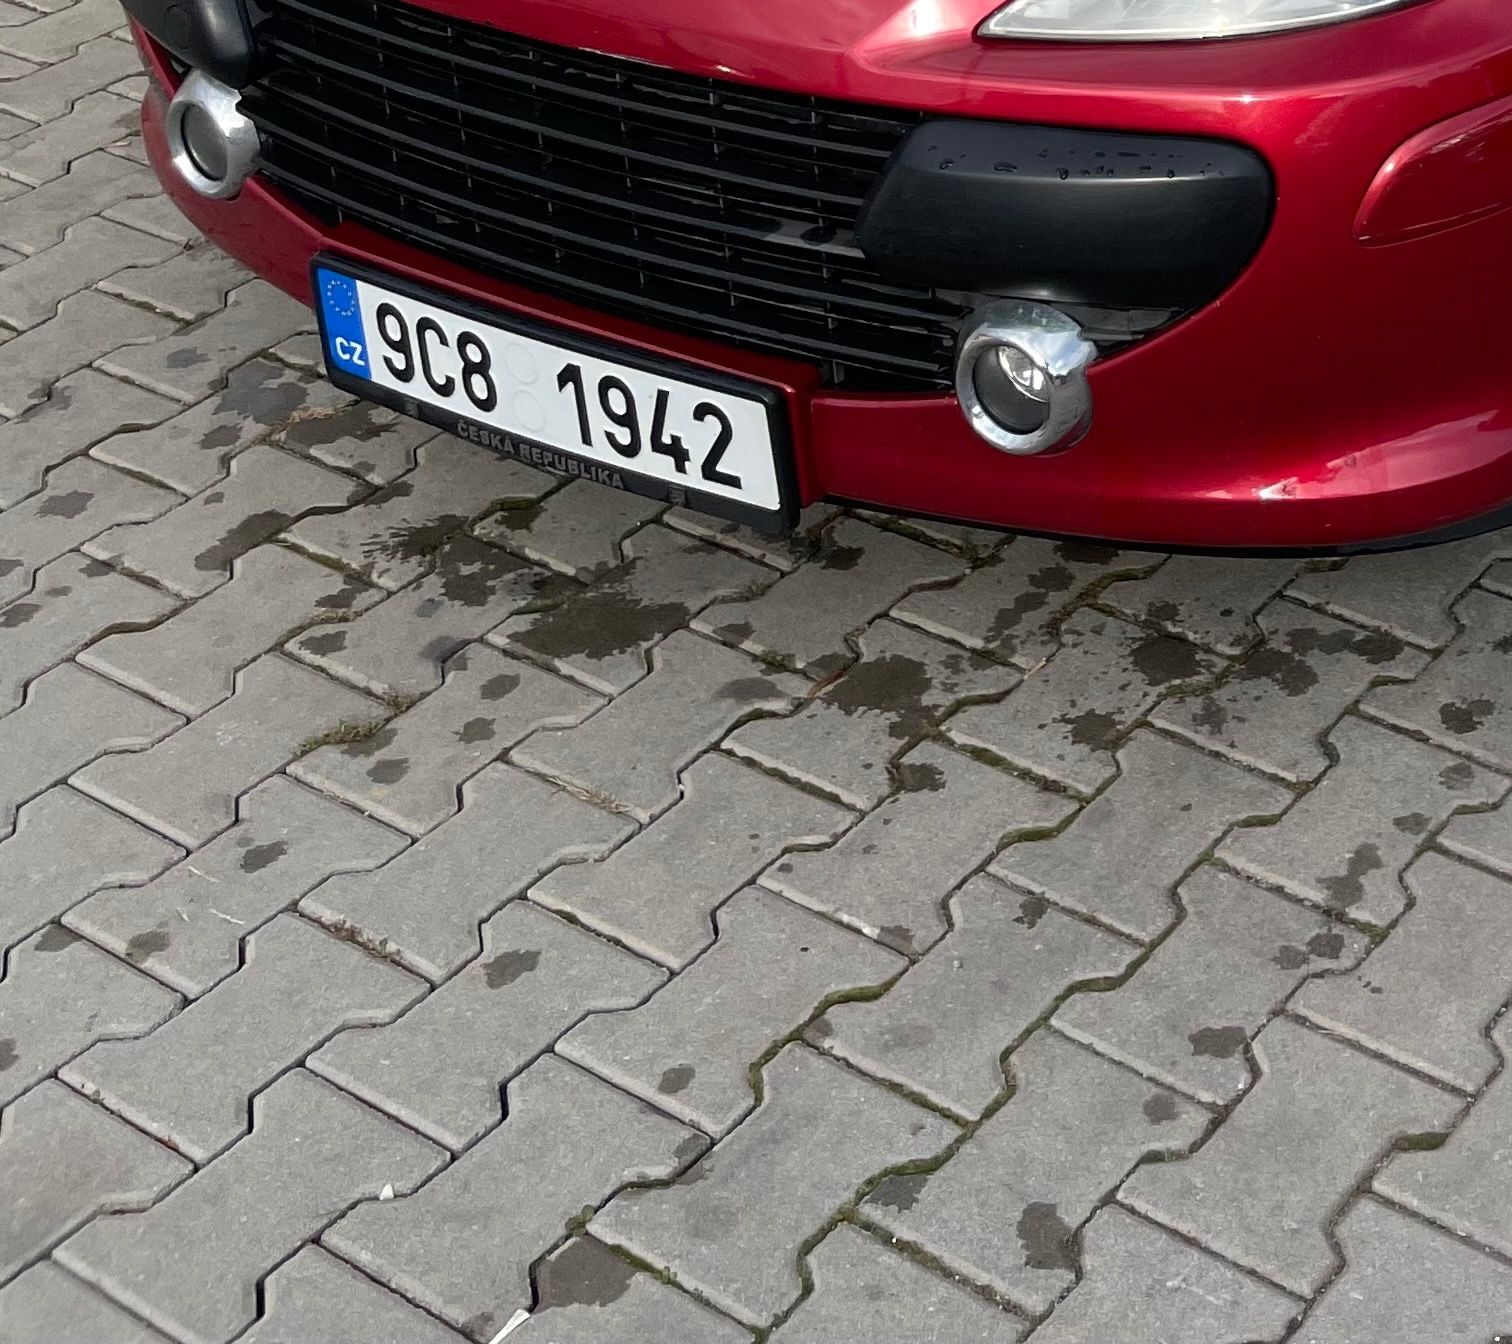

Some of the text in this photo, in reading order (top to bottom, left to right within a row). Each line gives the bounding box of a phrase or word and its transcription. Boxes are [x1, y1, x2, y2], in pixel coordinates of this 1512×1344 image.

[335, 302, 744, 490] CZ 9C8 1942
[519, 443, 625, 490] REPUBLIKA
